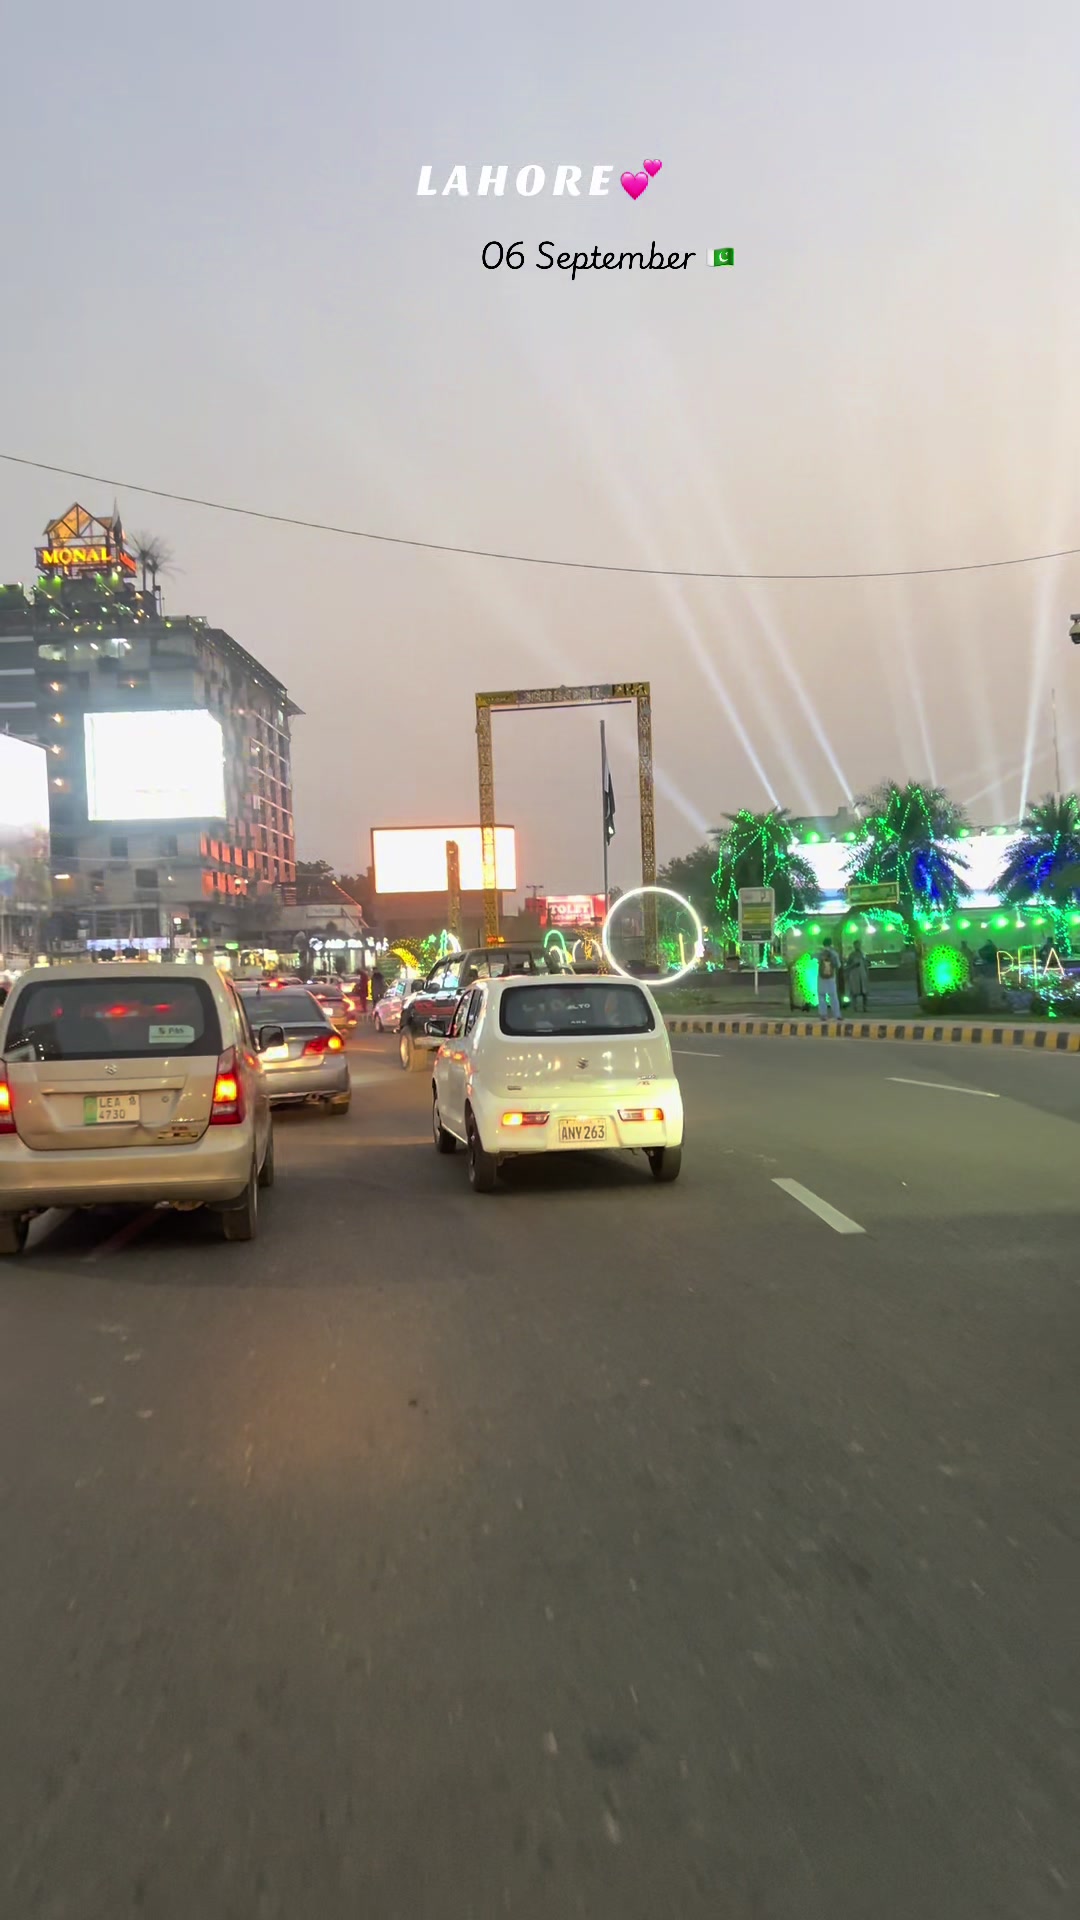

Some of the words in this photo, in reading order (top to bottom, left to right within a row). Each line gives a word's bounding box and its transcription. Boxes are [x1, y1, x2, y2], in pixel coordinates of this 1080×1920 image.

[42, 546, 113, 565] MONAL
[99, 1097, 121, 1109] LEA
[98, 1109, 126, 1120] 4730
[561, 1125, 583, 1141] ANY
[584, 1124, 606, 1140] 263
